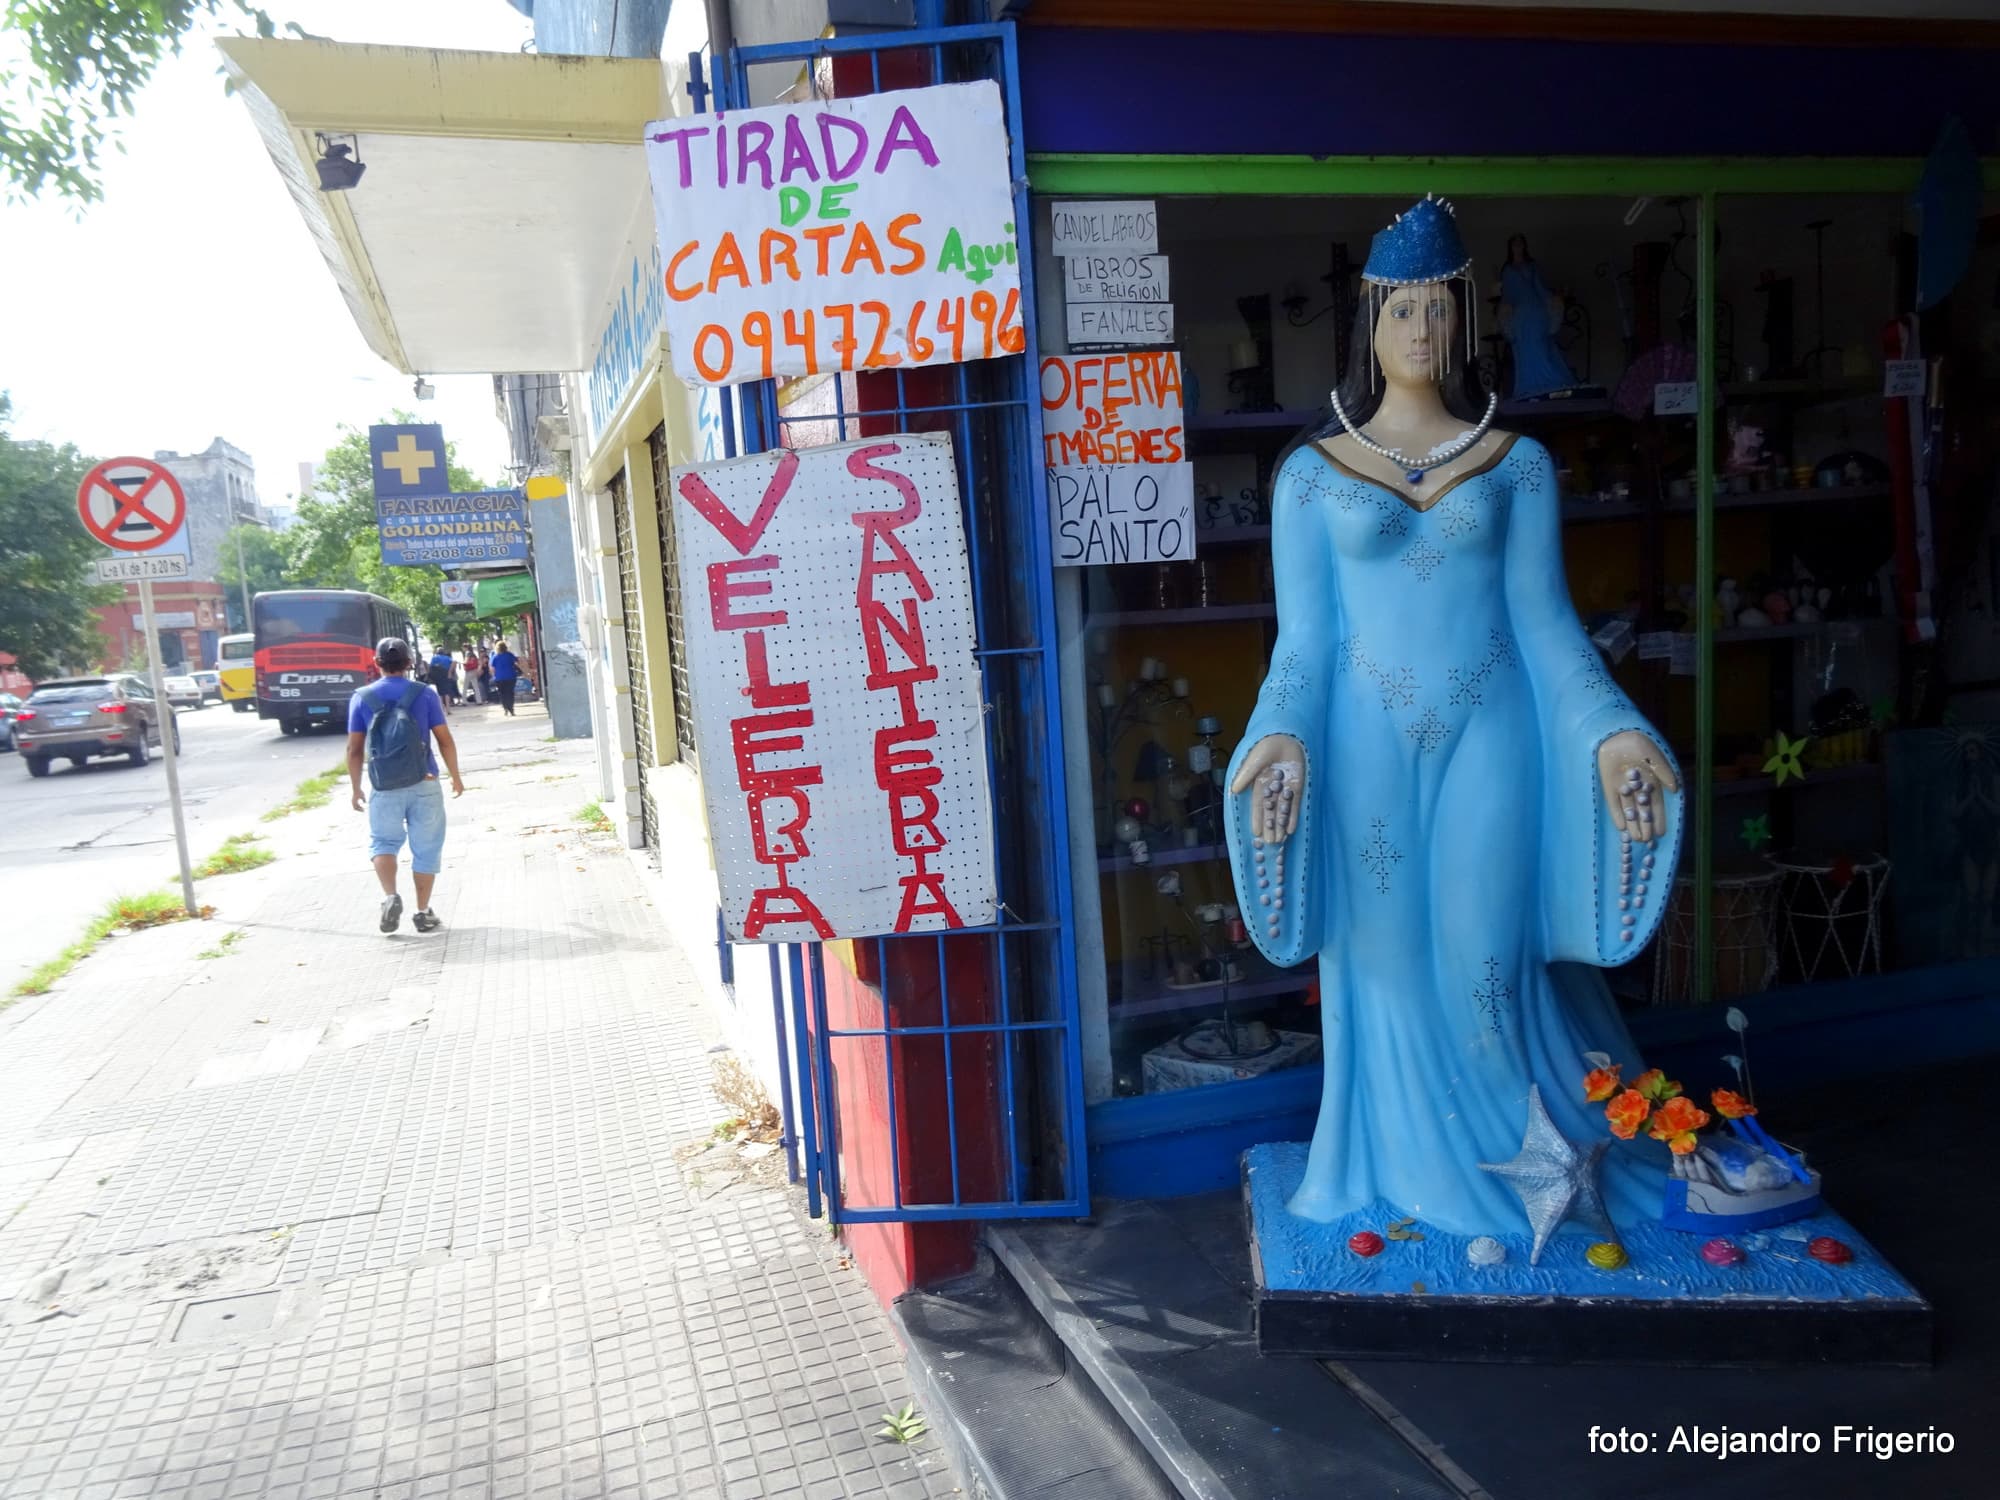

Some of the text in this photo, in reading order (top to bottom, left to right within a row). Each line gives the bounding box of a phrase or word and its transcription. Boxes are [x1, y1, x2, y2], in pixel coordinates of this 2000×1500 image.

[778, 182, 859, 227] DE
[665, 213, 926, 301] CARTAS
[1071, 256, 1153, 280] LIBROS
[1078, 283, 1094, 294] DE
[1080, 309, 1169, 335] FANALES
[693, 288, 1025, 382] 094726496
[1040, 351, 1184, 411] OFERTA
[1082, 406, 1123, 431] DE
[1043, 425, 1182, 468] IMAGENES
[379, 494, 521, 517] FARMACIA
[382, 519, 522, 538] GOLONDRINA
[385, 512, 513, 525] COMUNITARIA
[421, 544, 510, 561] 2408 48 80
[159, 559, 168, 574] 20
[279, 672, 354, 685] COPSA
[846, 443, 965, 933] SANTERIA
[279, 688, 301, 697] 86
[679, 451, 838, 940] VELERIA
